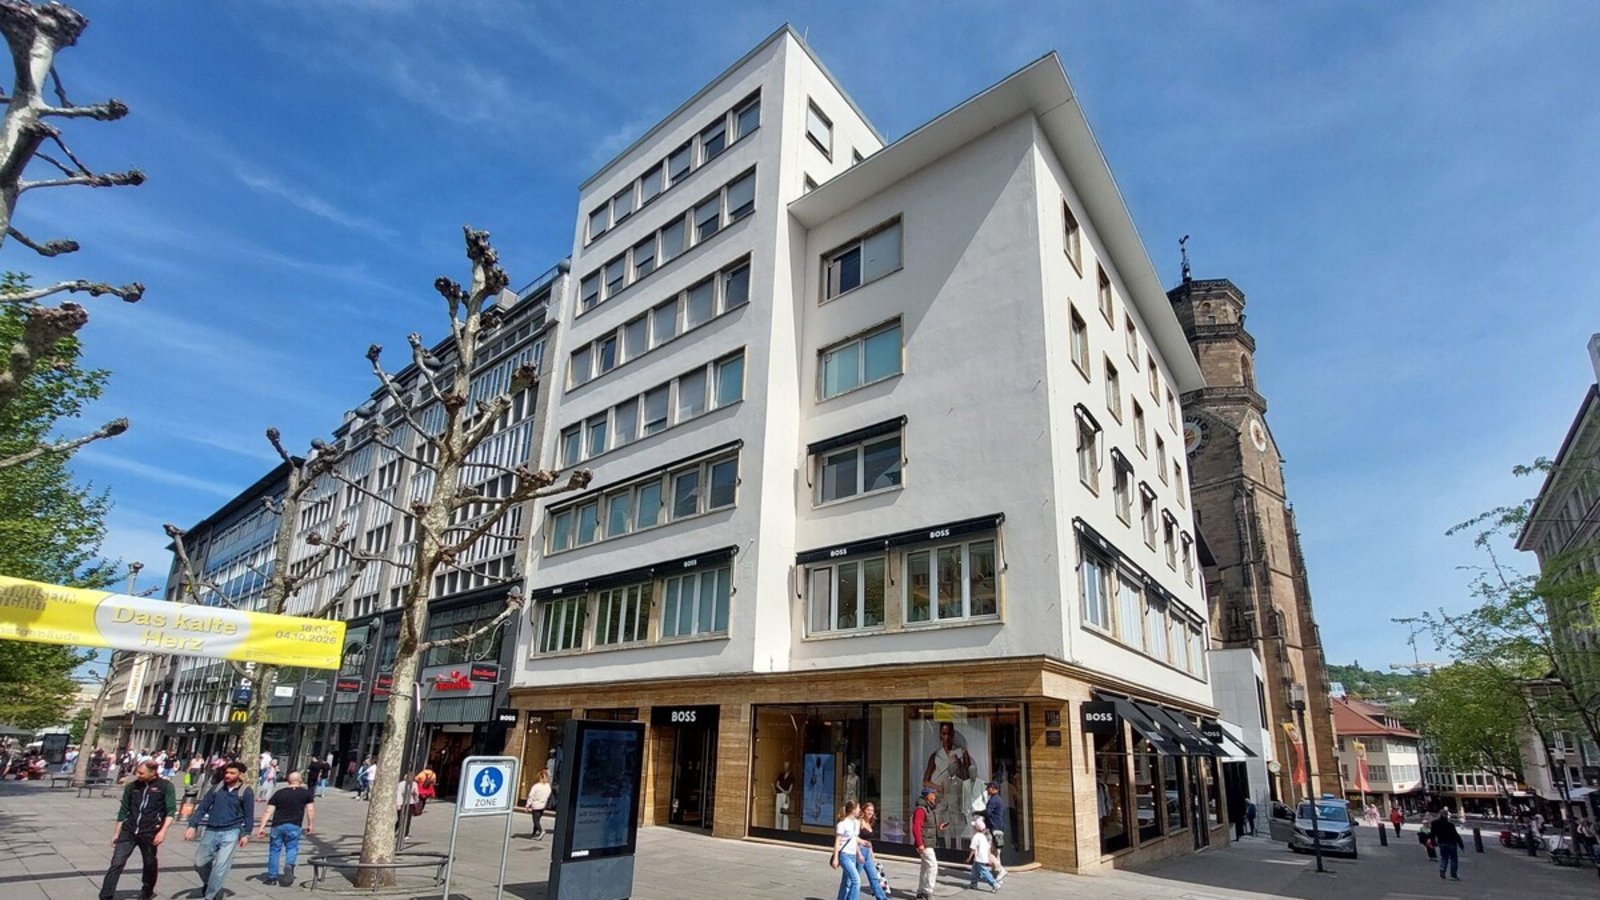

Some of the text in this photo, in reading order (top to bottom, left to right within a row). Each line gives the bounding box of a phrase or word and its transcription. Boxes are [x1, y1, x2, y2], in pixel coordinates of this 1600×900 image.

[929, 529, 950, 539] BOSS
[830, 549, 847, 557] BOSS
[112, 607, 238, 635] Das kalte
[142, 630, 205, 652] Herz
[275, 630, 337, 645] 04.10.2026
[500, 714, 516, 722] BOSS
[671, 710, 697, 723] BOSS
[1085, 712, 1113, 722] BOSS
[474, 798, 497, 807] ZONE
